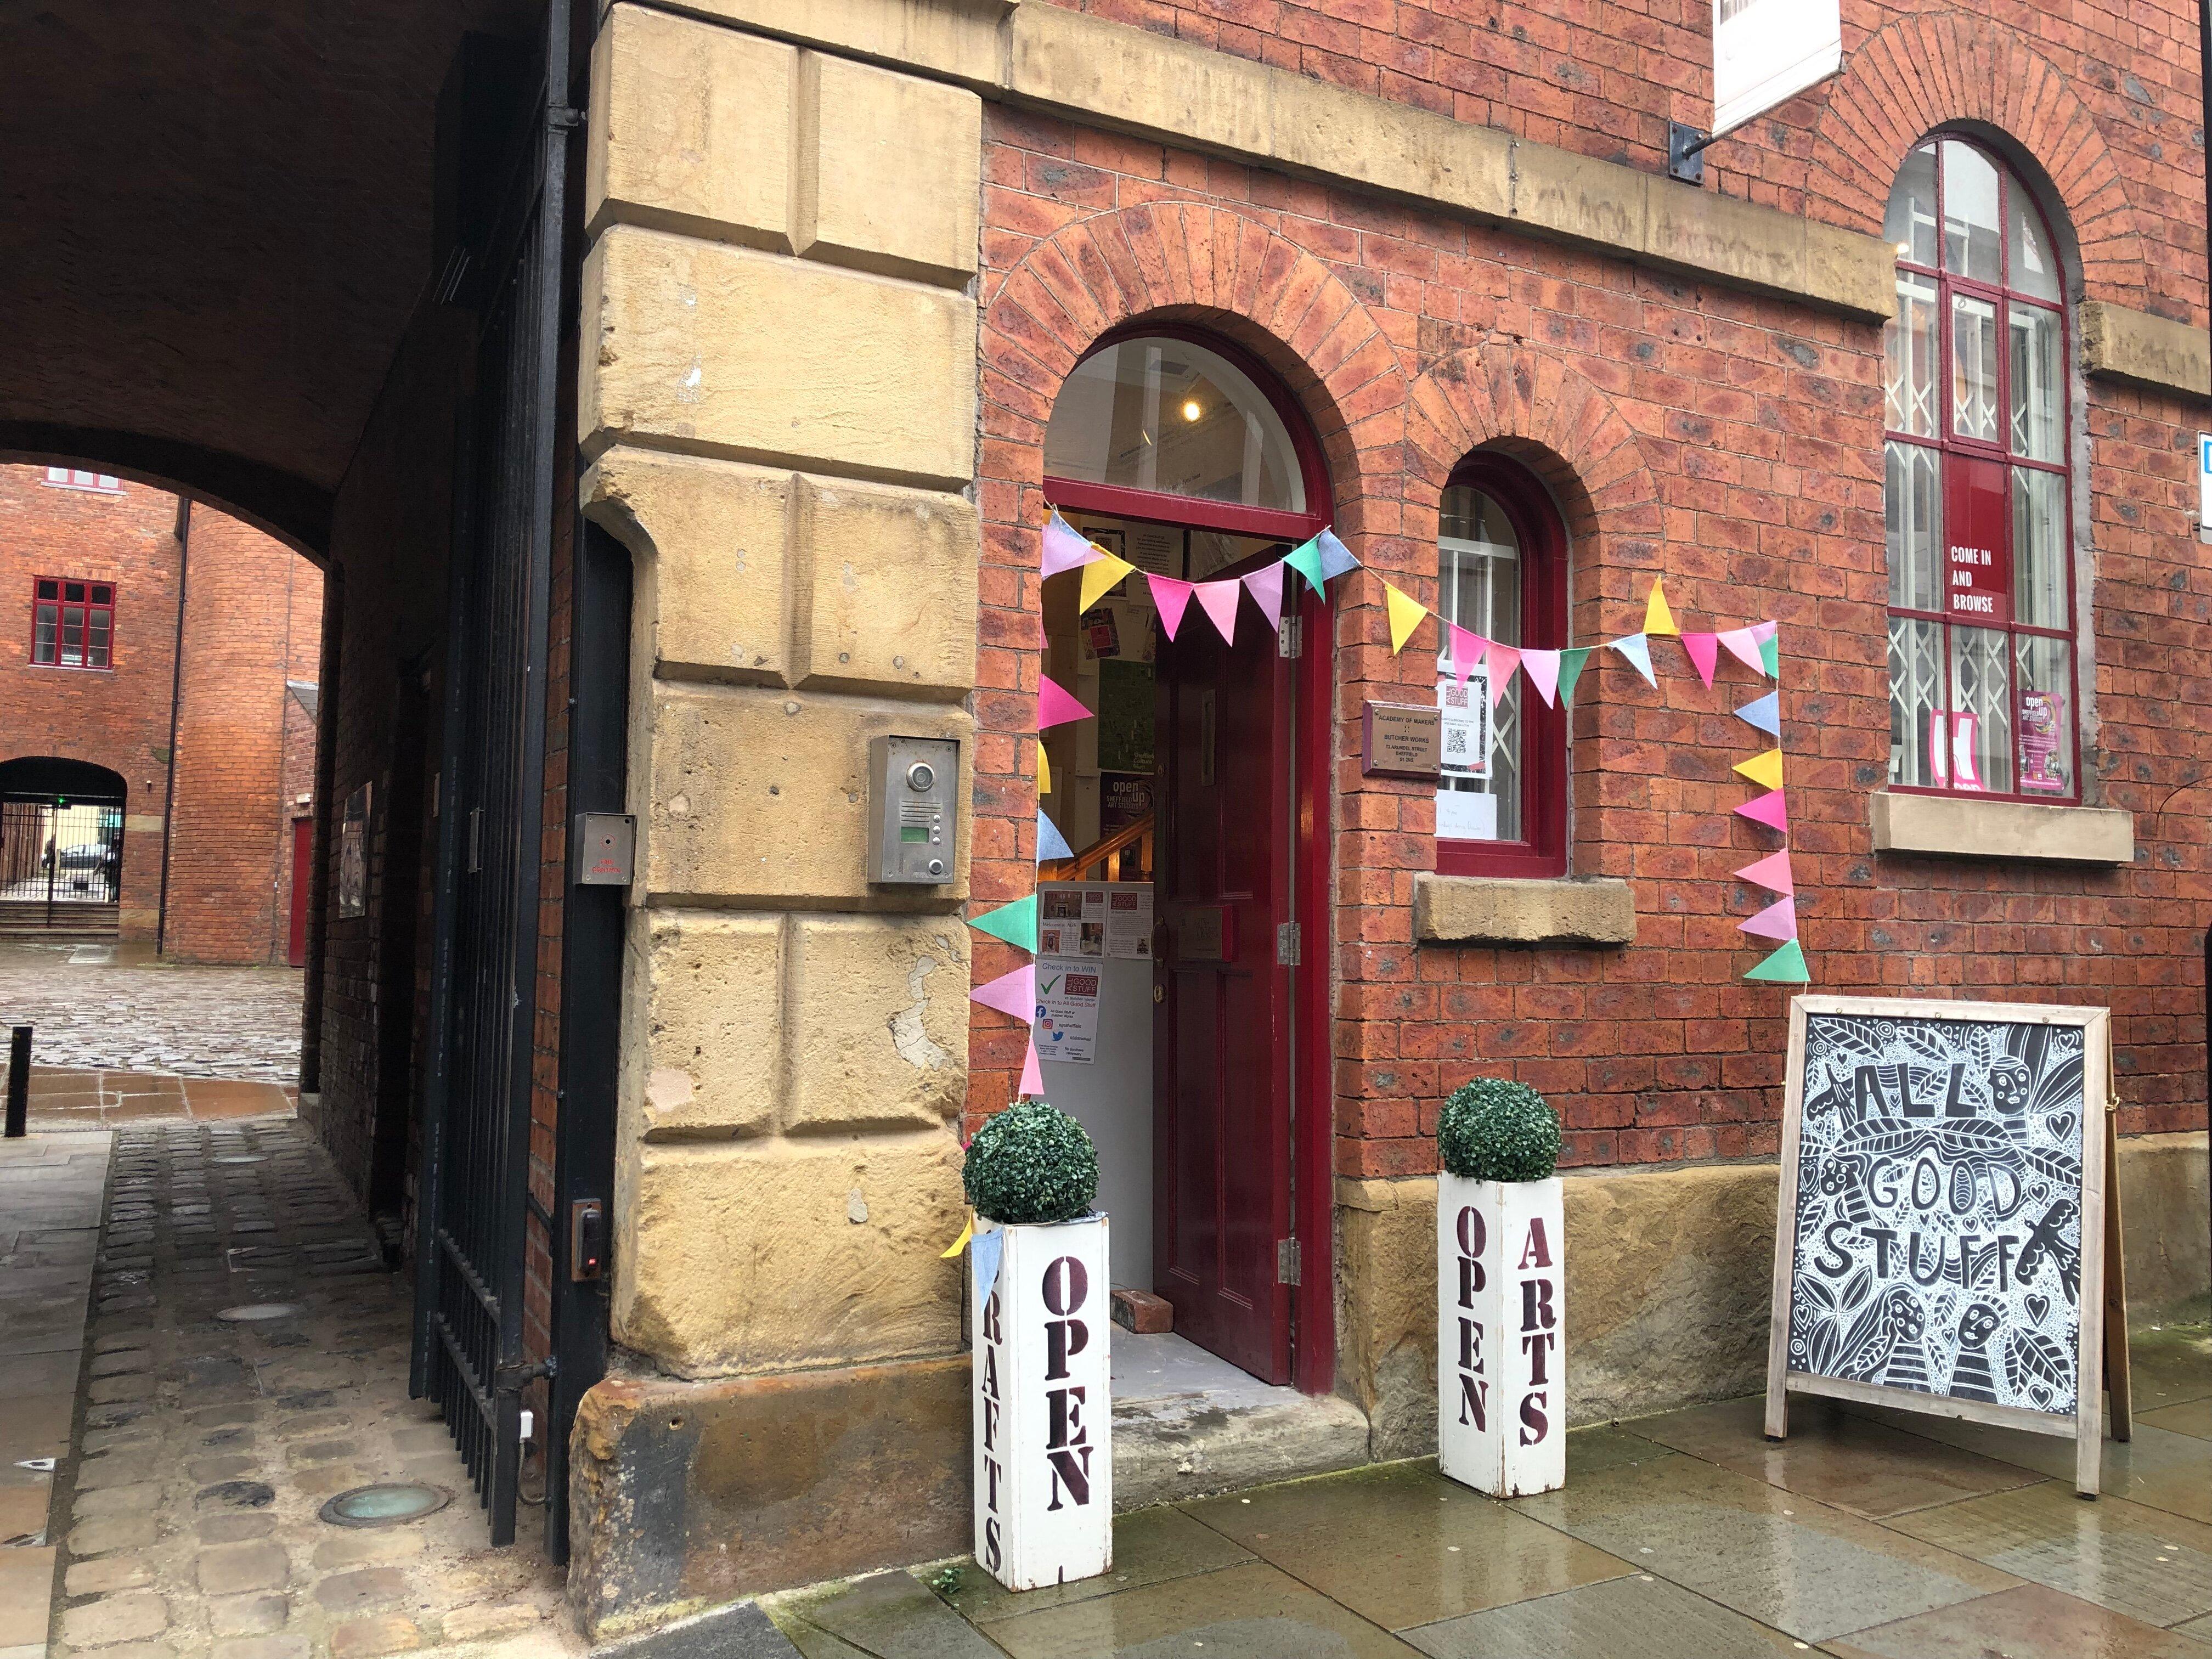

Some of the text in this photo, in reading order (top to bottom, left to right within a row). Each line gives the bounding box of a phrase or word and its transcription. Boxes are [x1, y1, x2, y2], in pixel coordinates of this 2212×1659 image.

[1951, 546, 1991, 566] COME IN
[1953, 569, 1972, 587] AND
[1953, 594, 1994, 613] BROWSE
[1451, 688, 1468, 697] GOOD
[1451, 697, 1468, 706] STUFF
[2026, 696, 2043, 710] open
[2039, 707, 2047, 720] up
[1113, 781, 1139, 795] open
[1106, 795, 1132, 803] SHEFFIELD
[1132, 792, 1145, 806] up
[1042, 963, 1063, 971] Check
[1073, 978, 1097, 986] GOOD
[1855, 1061, 1977, 1122] ALL
[1867, 1156, 2021, 1219] GOOD
[1813, 1220, 2020, 1294] STUFF
[1456, 1205, 1487, 1433] OPEN
[1517, 1217, 1557, 1448] ARTS
[1041, 1255, 1094, 1512] OPEN
[981, 1229, 1003, 1573] RAFTS
